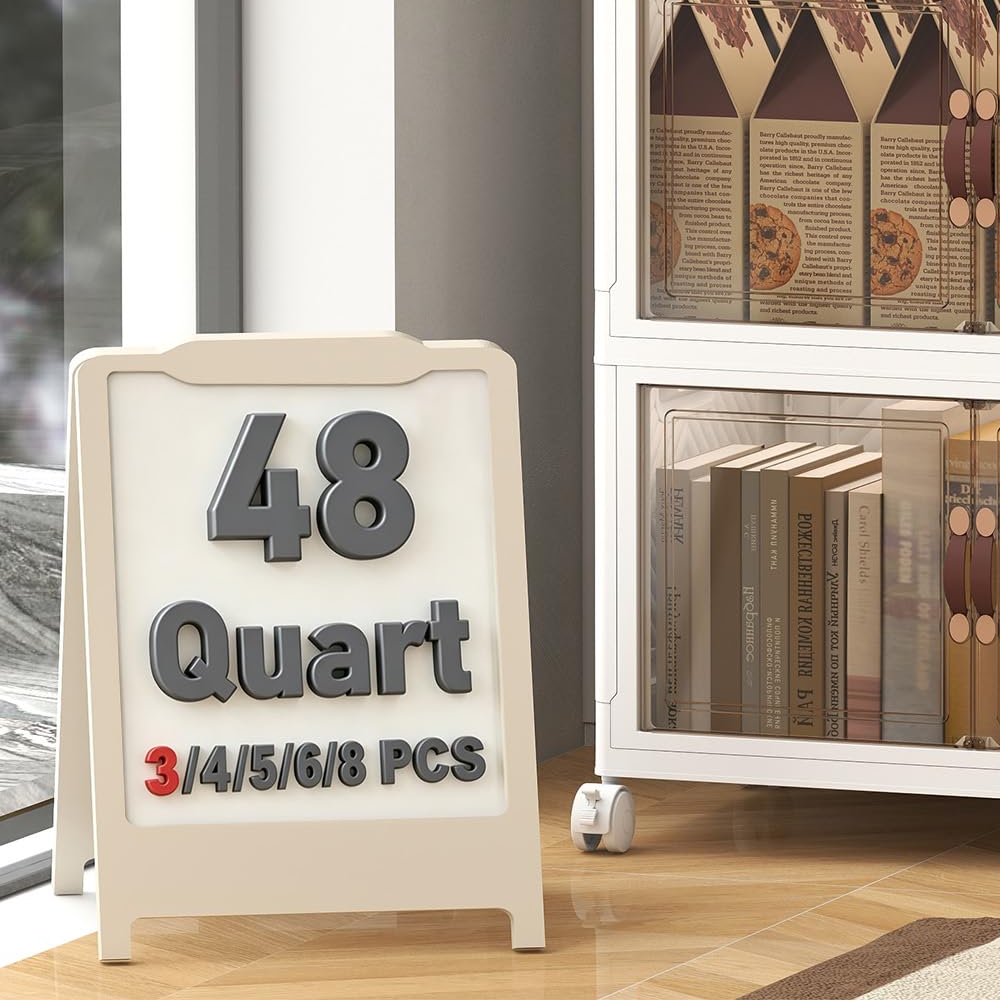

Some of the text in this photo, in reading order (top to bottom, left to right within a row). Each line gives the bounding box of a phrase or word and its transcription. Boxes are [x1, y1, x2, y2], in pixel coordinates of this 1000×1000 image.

[206, 410, 416, 564] 48
[858, 504, 870, 537] Carol
[858, 541, 871, 584] Shields
[148, 598, 473, 704] Quart
[144, 736, 488, 798] 3/4/5/6/8 PCS
